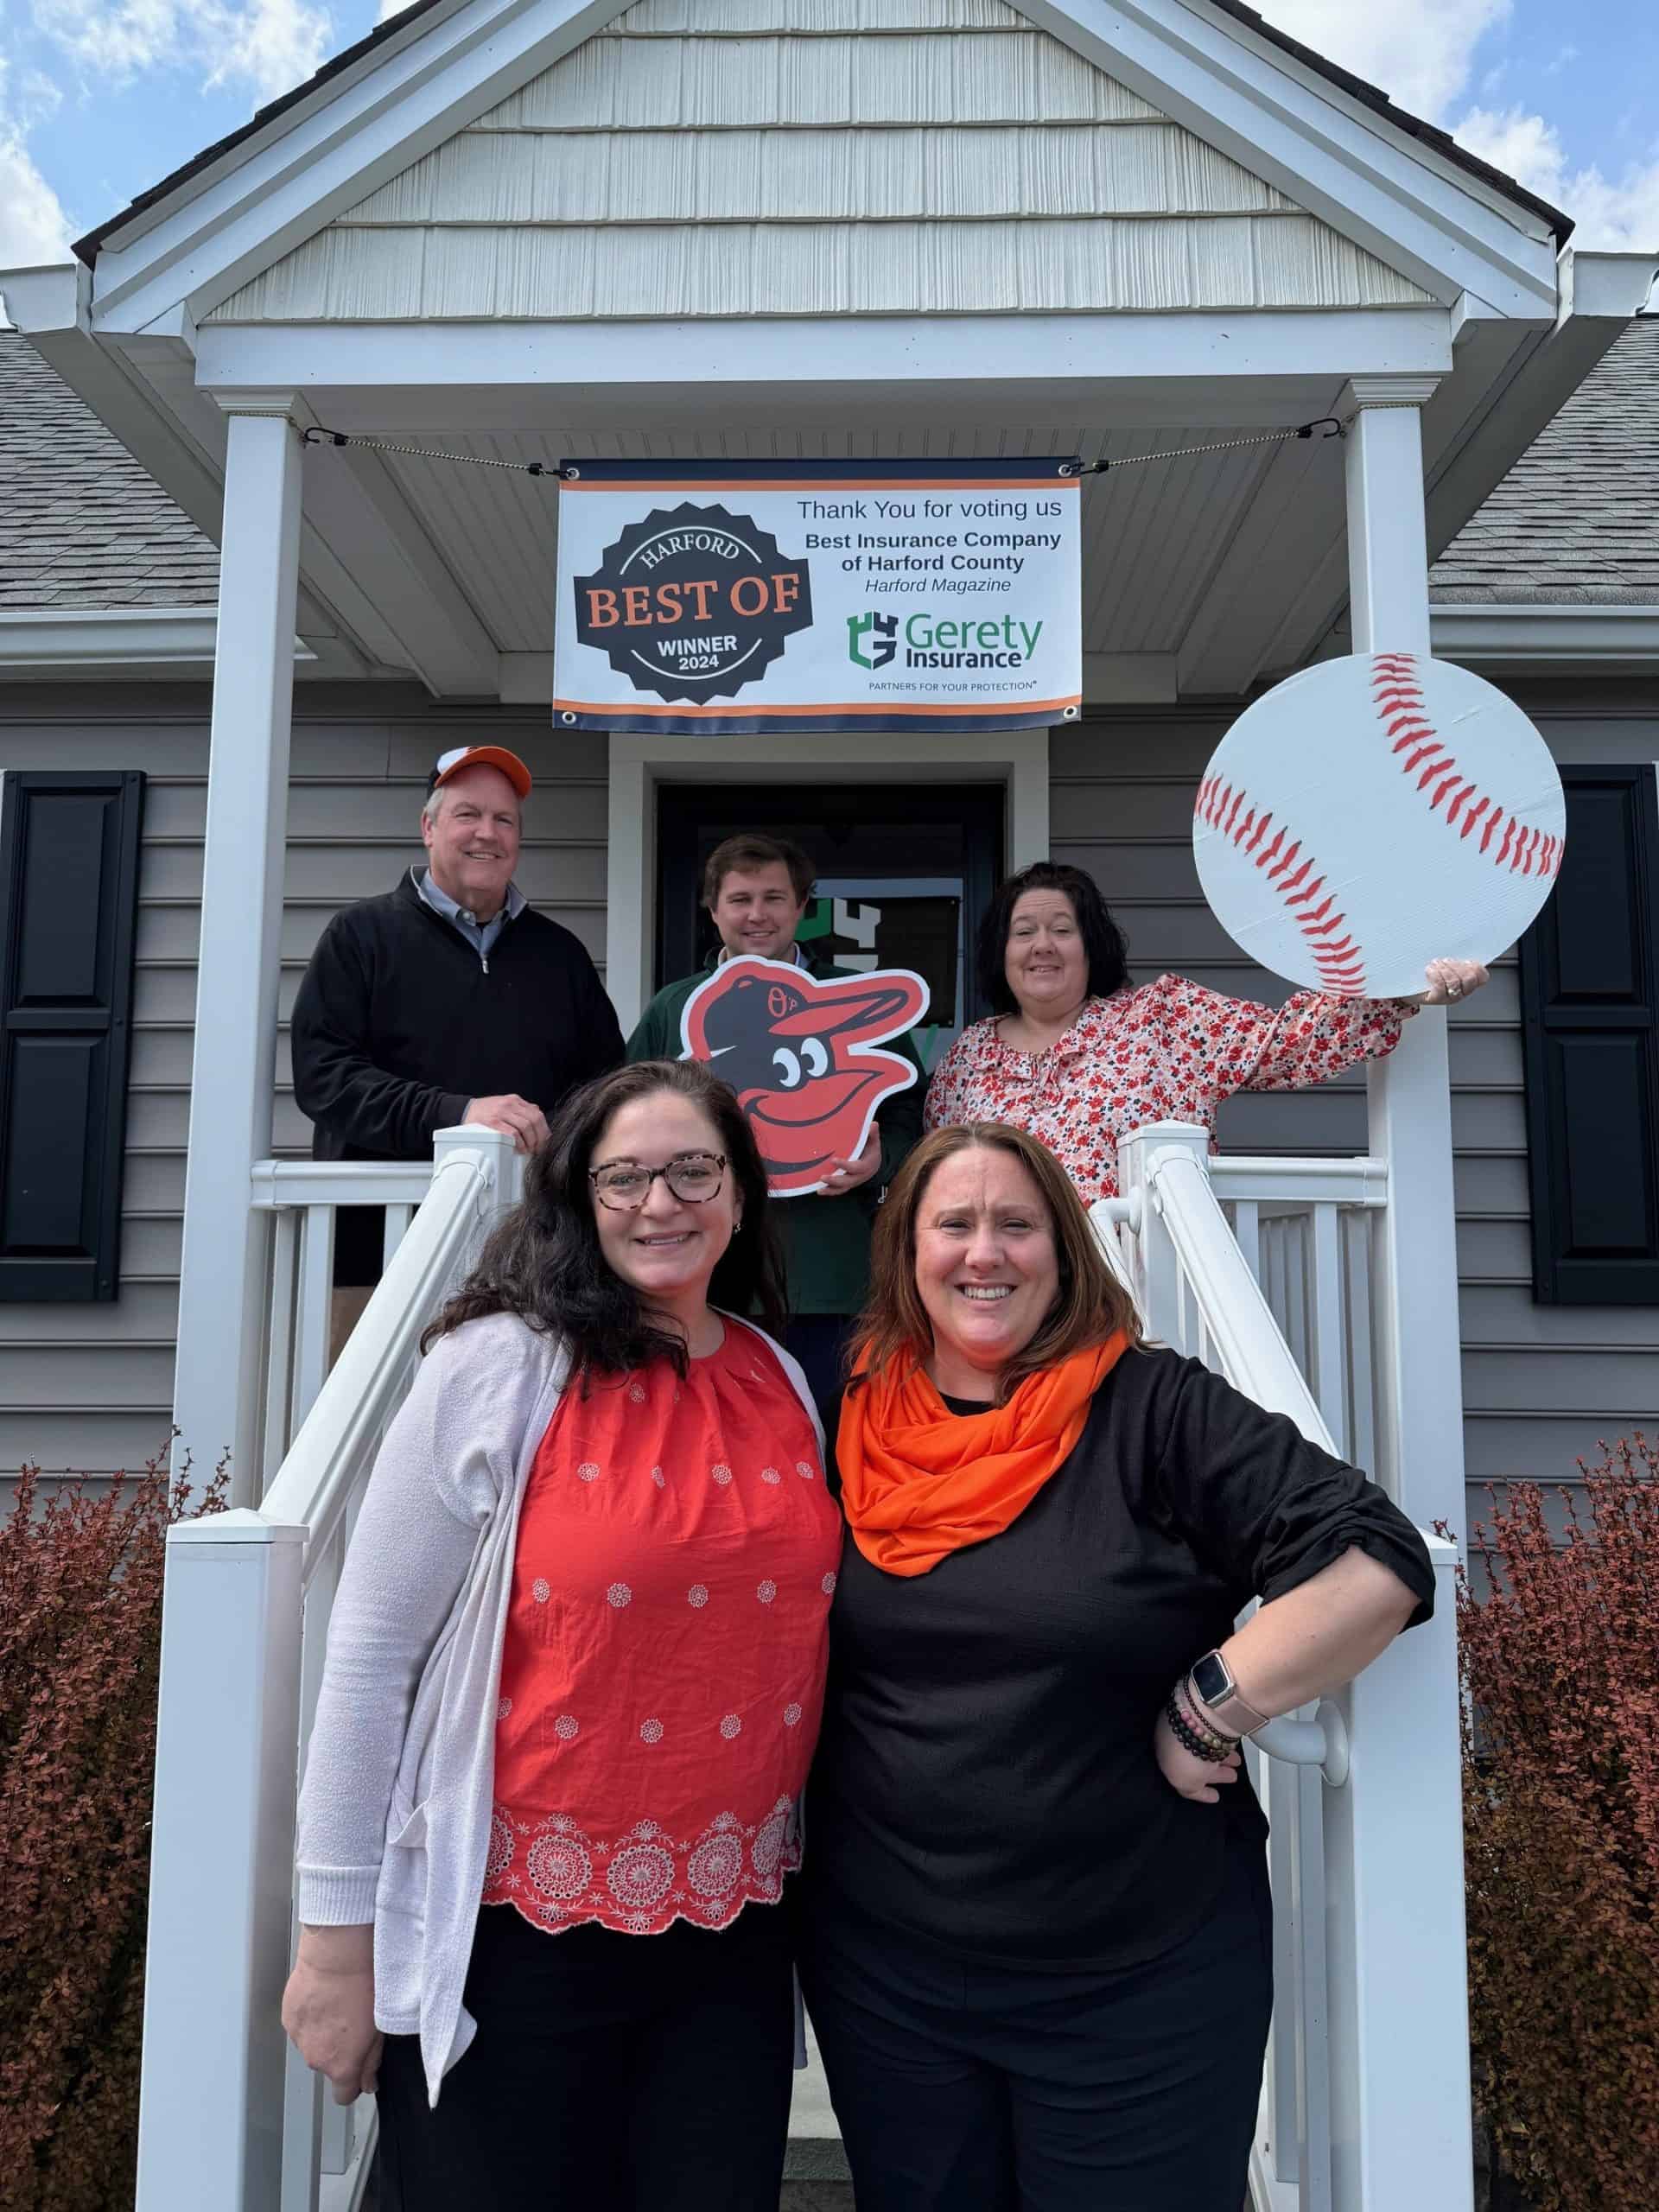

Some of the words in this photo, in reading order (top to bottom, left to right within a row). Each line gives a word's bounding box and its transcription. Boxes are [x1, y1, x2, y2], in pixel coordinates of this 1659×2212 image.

[797, 499, 868, 518] Thank
[874, 500, 916, 518] You
[924, 499, 953, 518] for
[960, 499, 1027, 520] voting
[1036, 500, 1062, 517] us
[639, 533, 739, 569] HARFORD
[805, 533, 851, 549] Best
[858, 532, 958, 548] Insurance
[964, 531, 1062, 550] Company
[842, 556, 863, 571] of
[868, 556, 944, 571] Harford
[950, 555, 1025, 573] County
[865, 578, 926, 593] Harford
[931, 578, 1012, 595] Magazine
[586, 580, 718, 628] BEST
[729, 573, 800, 616] OF
[657, 635, 738, 658] WINNER
[906, 613, 1044, 660] Gerety
[678, 654, 720, 671] 2024
[906, 648, 1022, 669] Insurance
[868, 682, 917, 690] PARTNERS
[941, 683, 968, 691] YOUR
